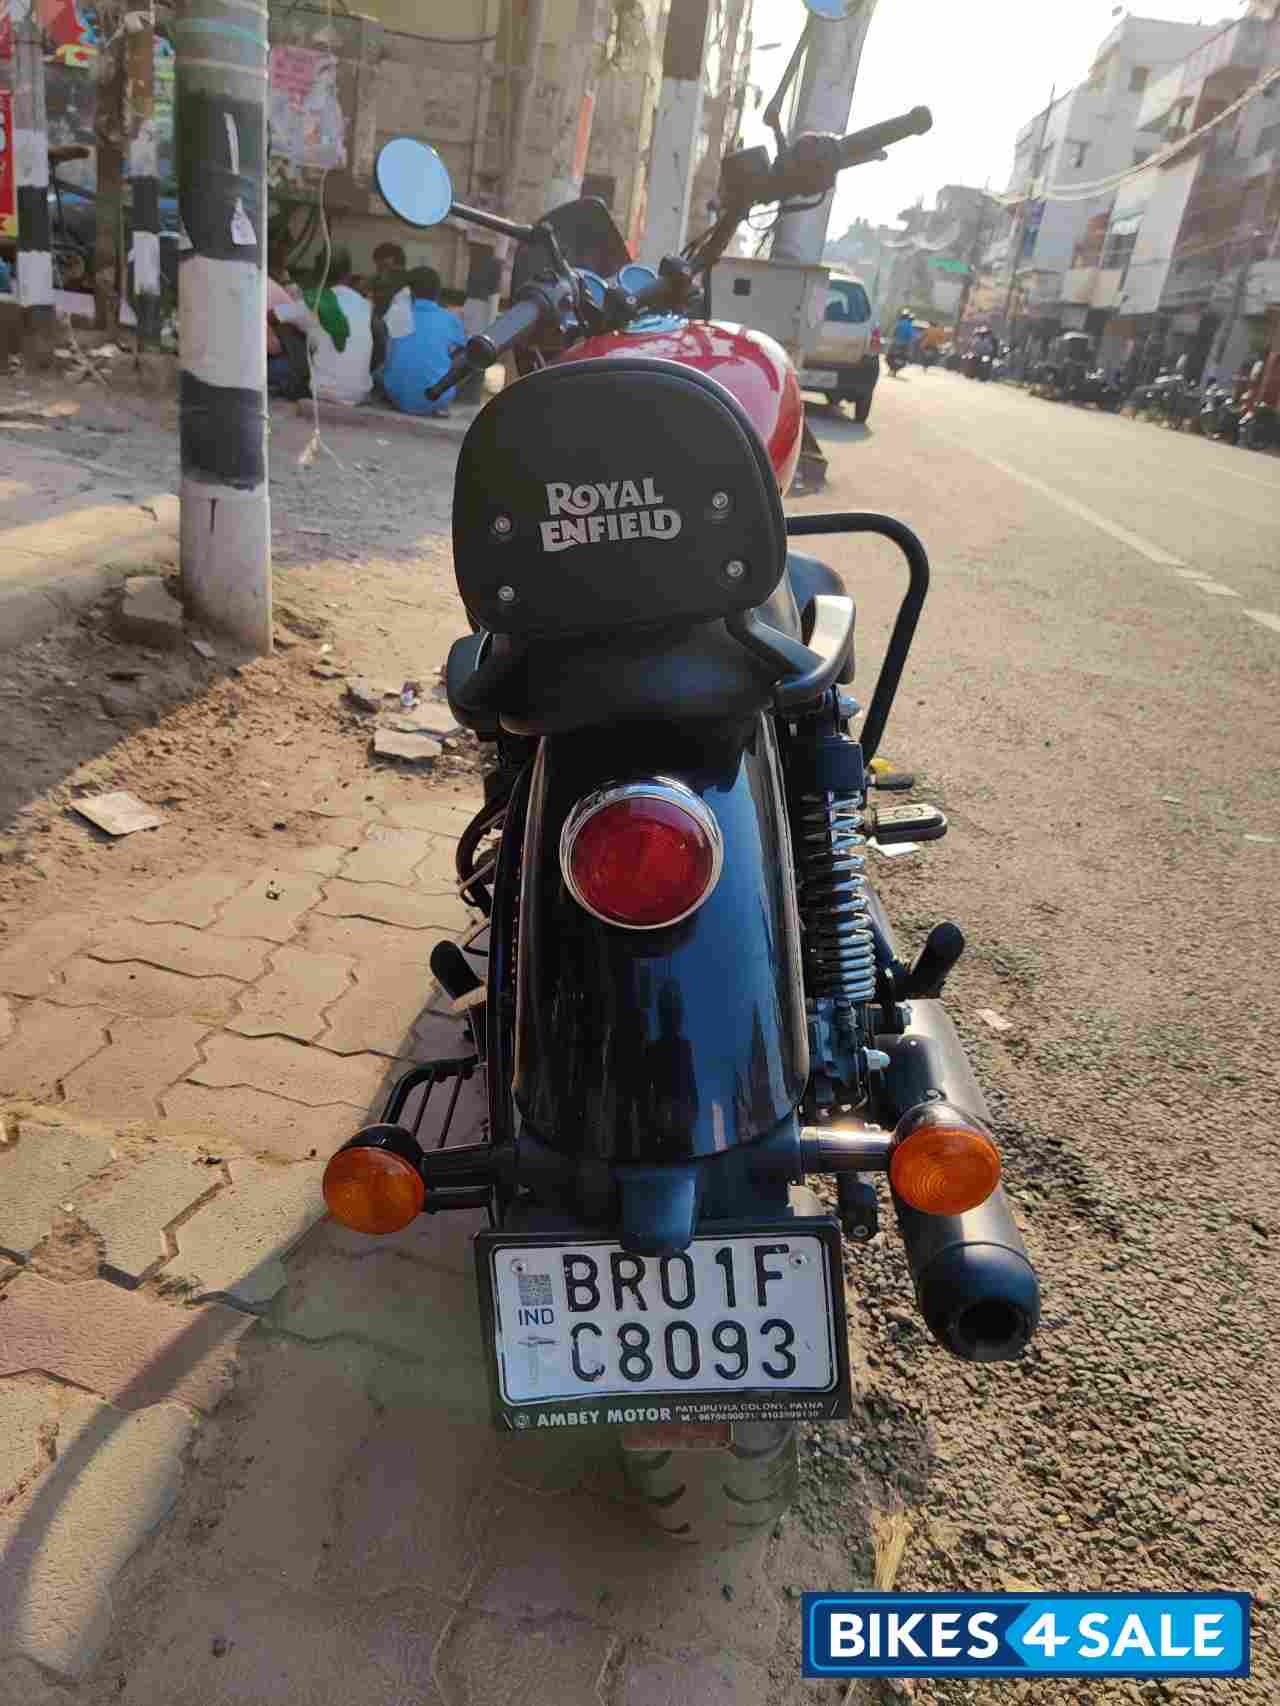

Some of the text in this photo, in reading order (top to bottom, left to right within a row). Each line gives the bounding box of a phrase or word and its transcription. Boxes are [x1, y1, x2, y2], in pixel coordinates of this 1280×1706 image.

[545, 477, 664, 515] ROYAL
[539, 509, 682, 552] ENFIELD
[561, 1243, 790, 1313] BR01F
[518, 1308, 554, 1326] IND
[570, 1318, 797, 1383] C8093
[536, 1409, 600, 1427] AMBEY
[607, 1407, 672, 1424] MOTOR
